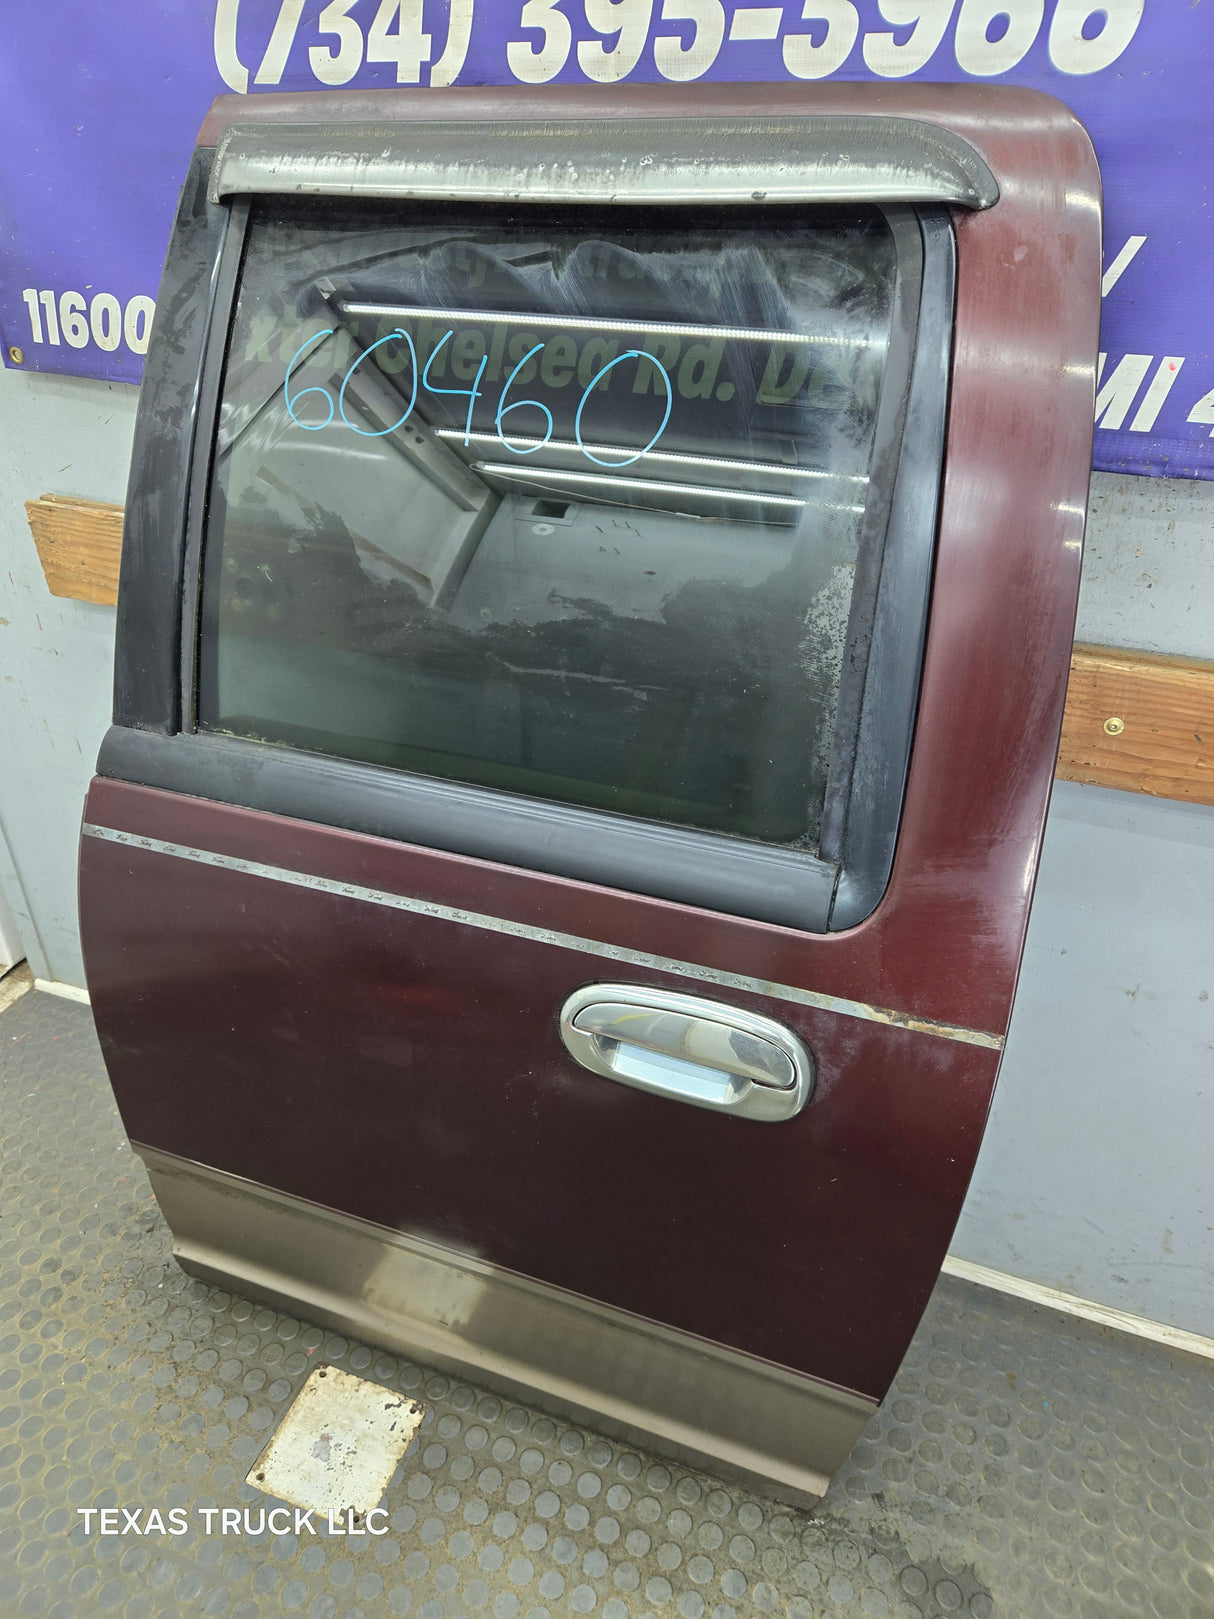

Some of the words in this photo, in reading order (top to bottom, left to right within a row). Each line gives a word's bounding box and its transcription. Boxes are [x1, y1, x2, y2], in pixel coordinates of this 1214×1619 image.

[22, 288, 157, 355] 11600
[374, 314, 620, 391] Chelsea
[632, 331, 736, 402] Rd.
[285, 328, 672, 467] 60460
